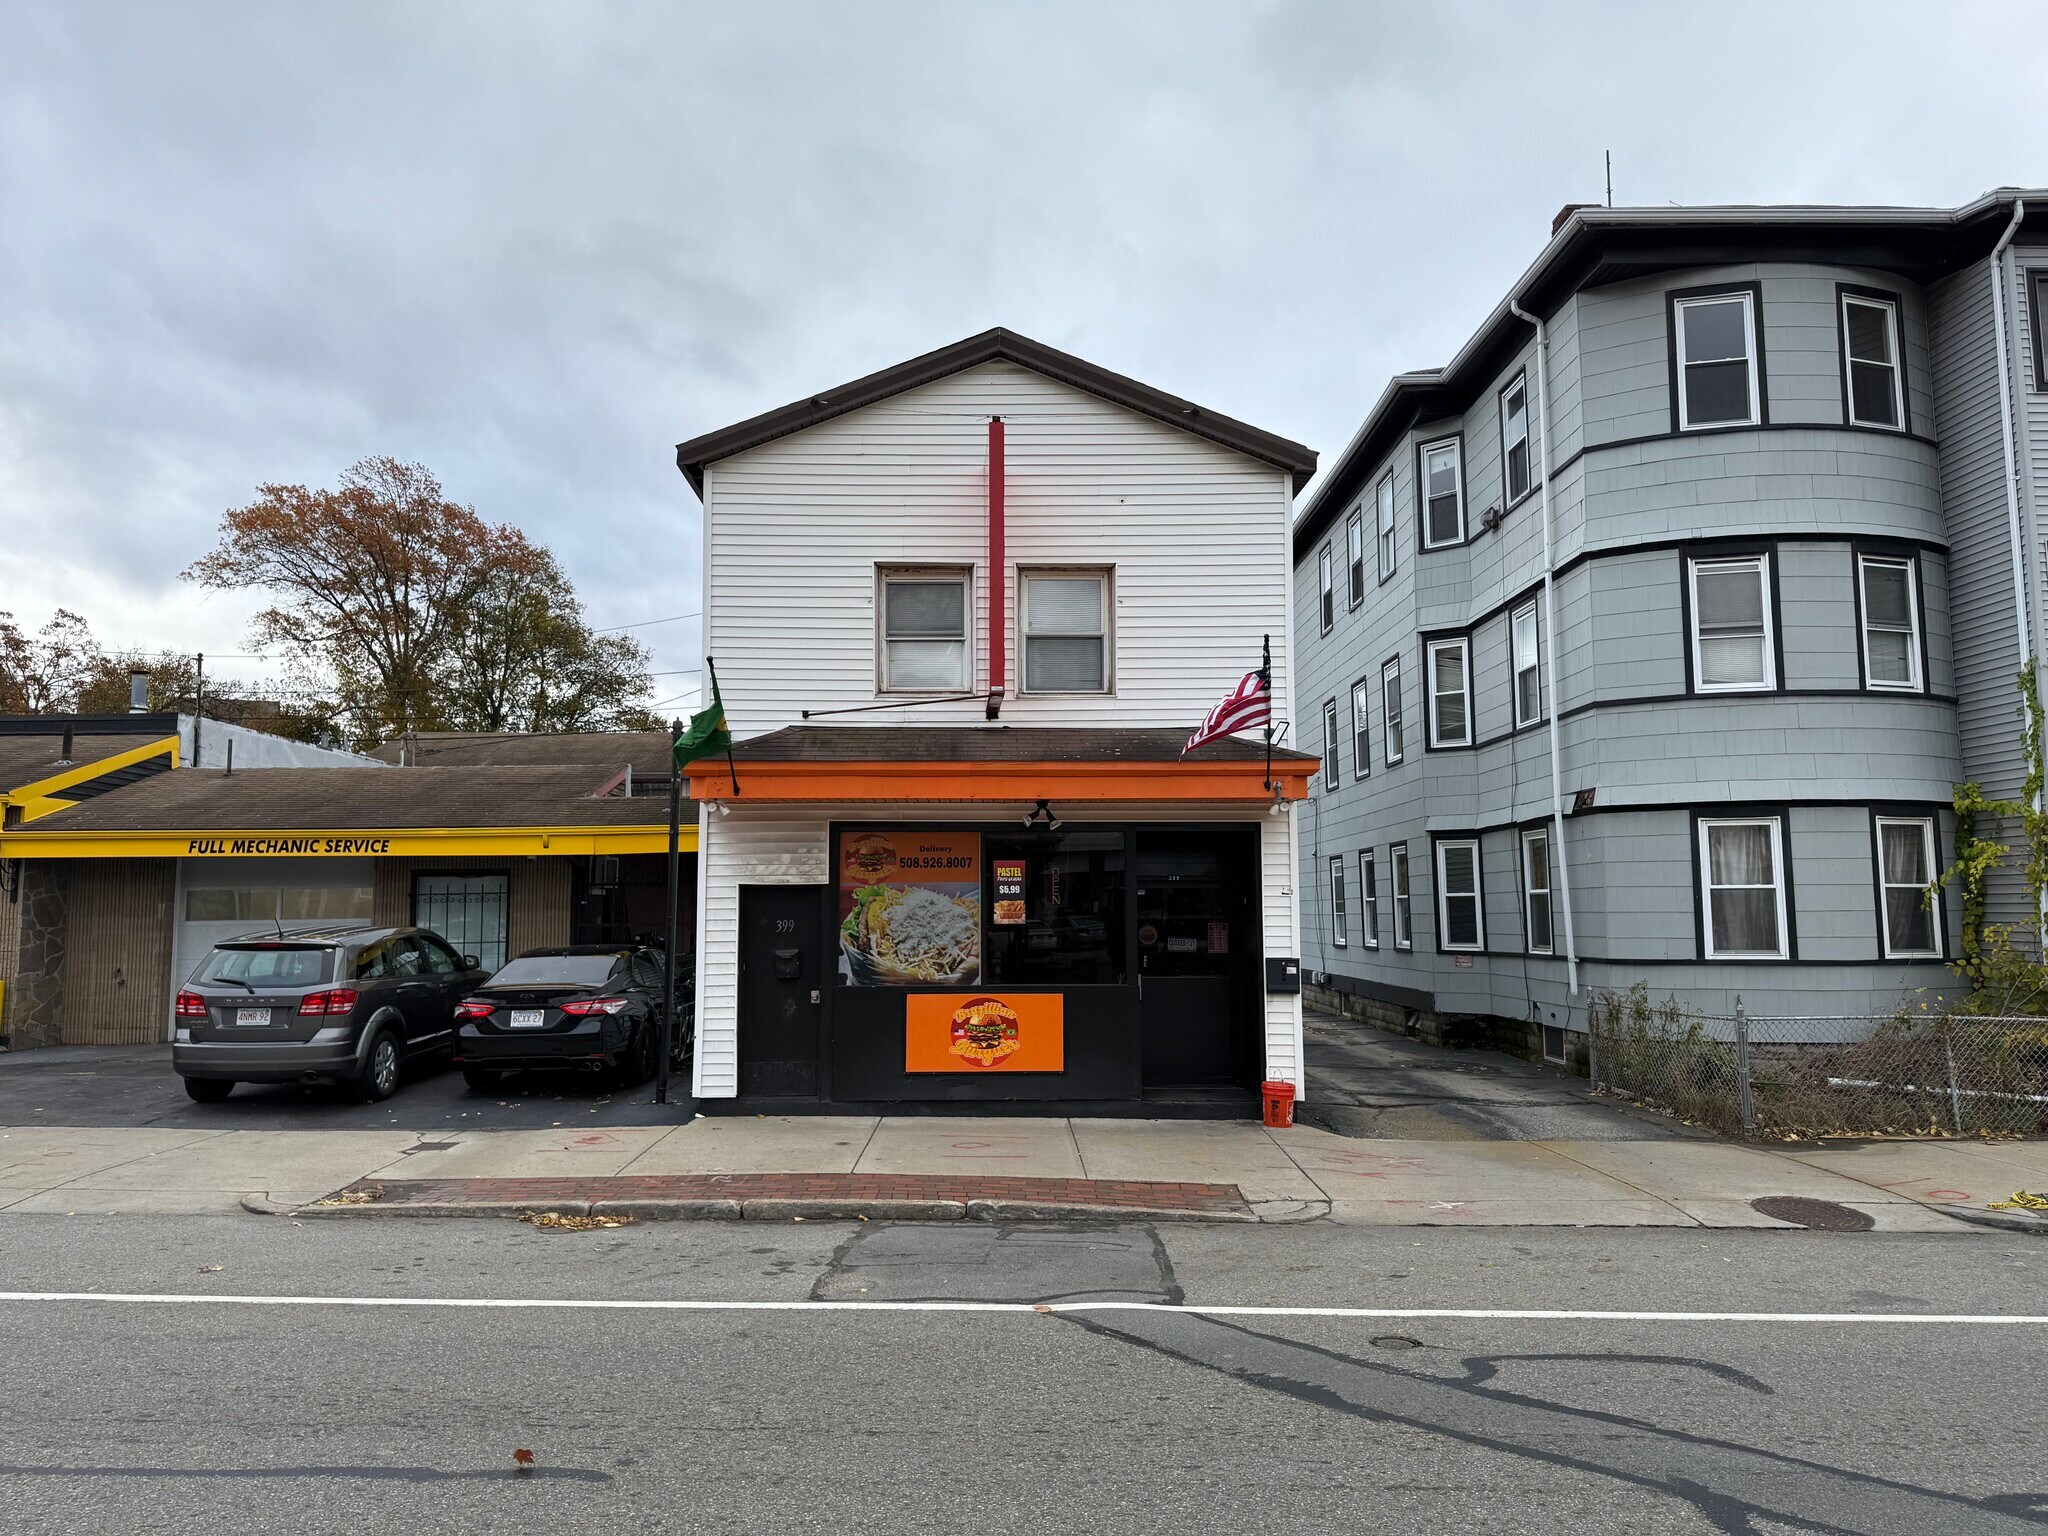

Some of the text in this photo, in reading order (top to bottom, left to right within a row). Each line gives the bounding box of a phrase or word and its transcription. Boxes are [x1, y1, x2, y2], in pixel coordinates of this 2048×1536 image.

[188, 839, 390, 854] FULL MECHANIC SERVICE
[900, 858, 973, 868] 508.926.8007
[997, 867, 1022, 877] PASTEL
[1052, 867, 1060, 905] OPEN
[776, 919, 795, 932] 399
[259, 1012, 269, 1021] 92
[953, 1002, 1017, 1023] Brazillian
